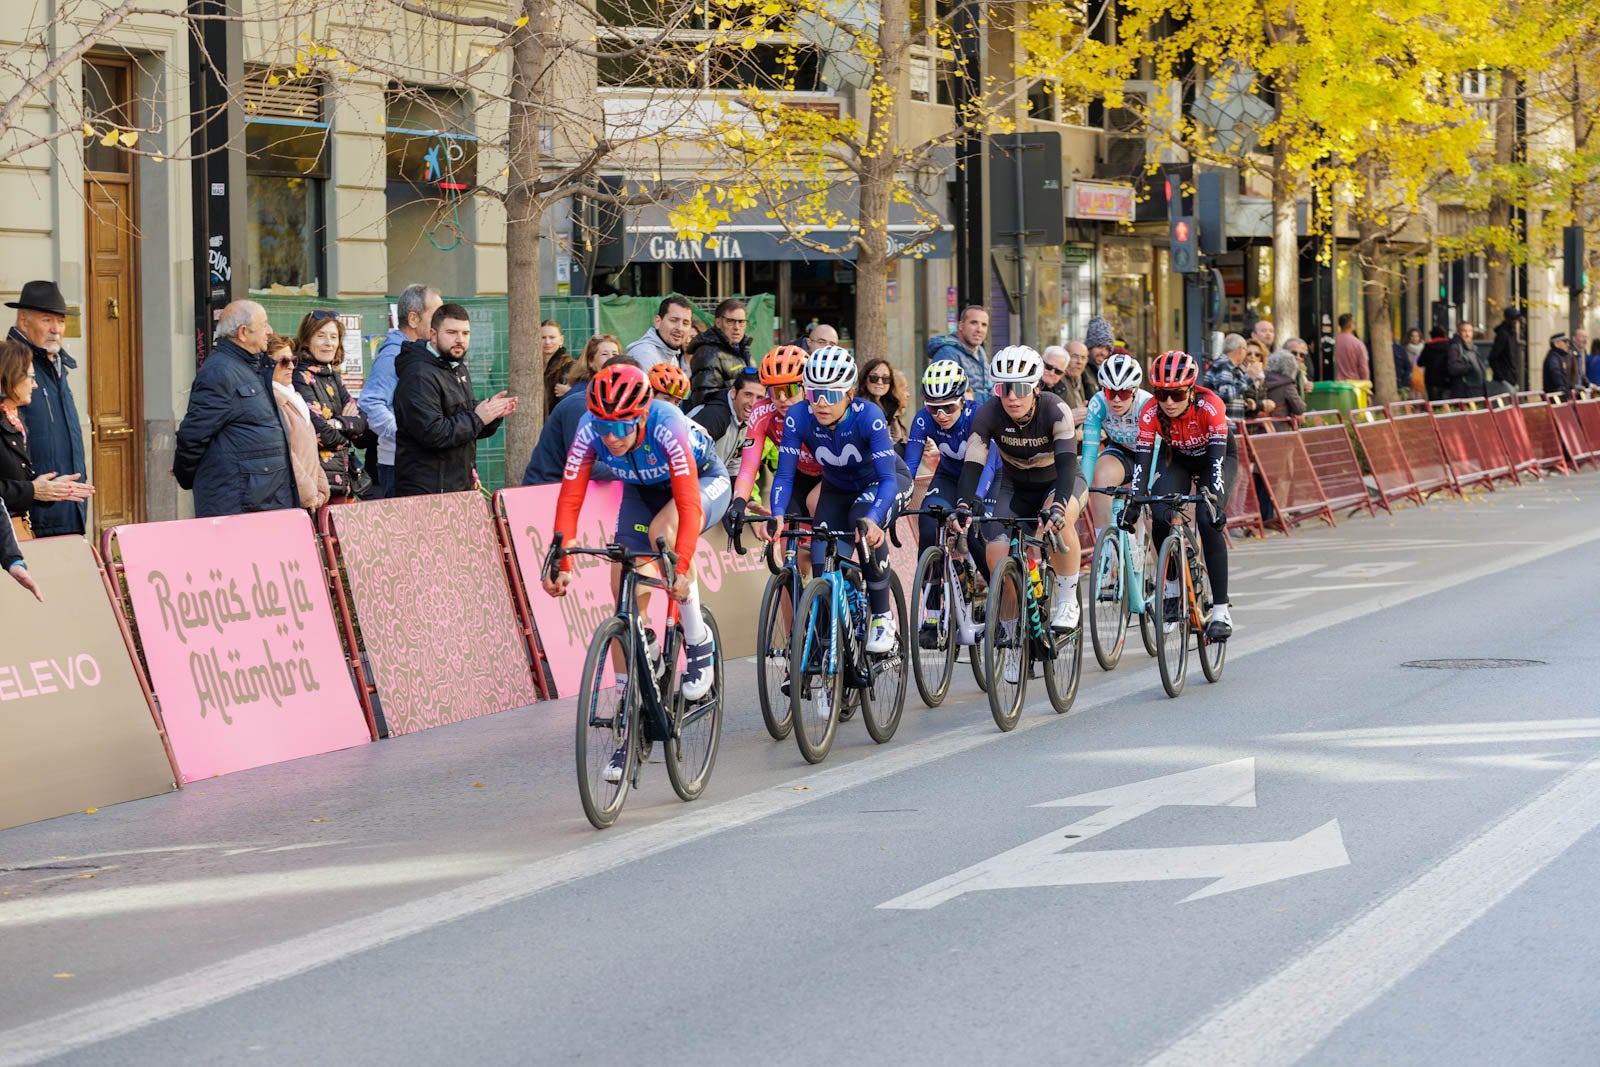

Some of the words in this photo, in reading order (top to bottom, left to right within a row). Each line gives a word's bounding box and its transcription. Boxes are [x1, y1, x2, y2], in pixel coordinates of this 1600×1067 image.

[650, 236, 702, 260] GRAN
[653, 423, 690, 476] CERATIZIT
[1001, 435, 1049, 447] DISRUPTORS
[612, 463, 670, 480] ERATIZI
[252, 562, 286, 618] de
